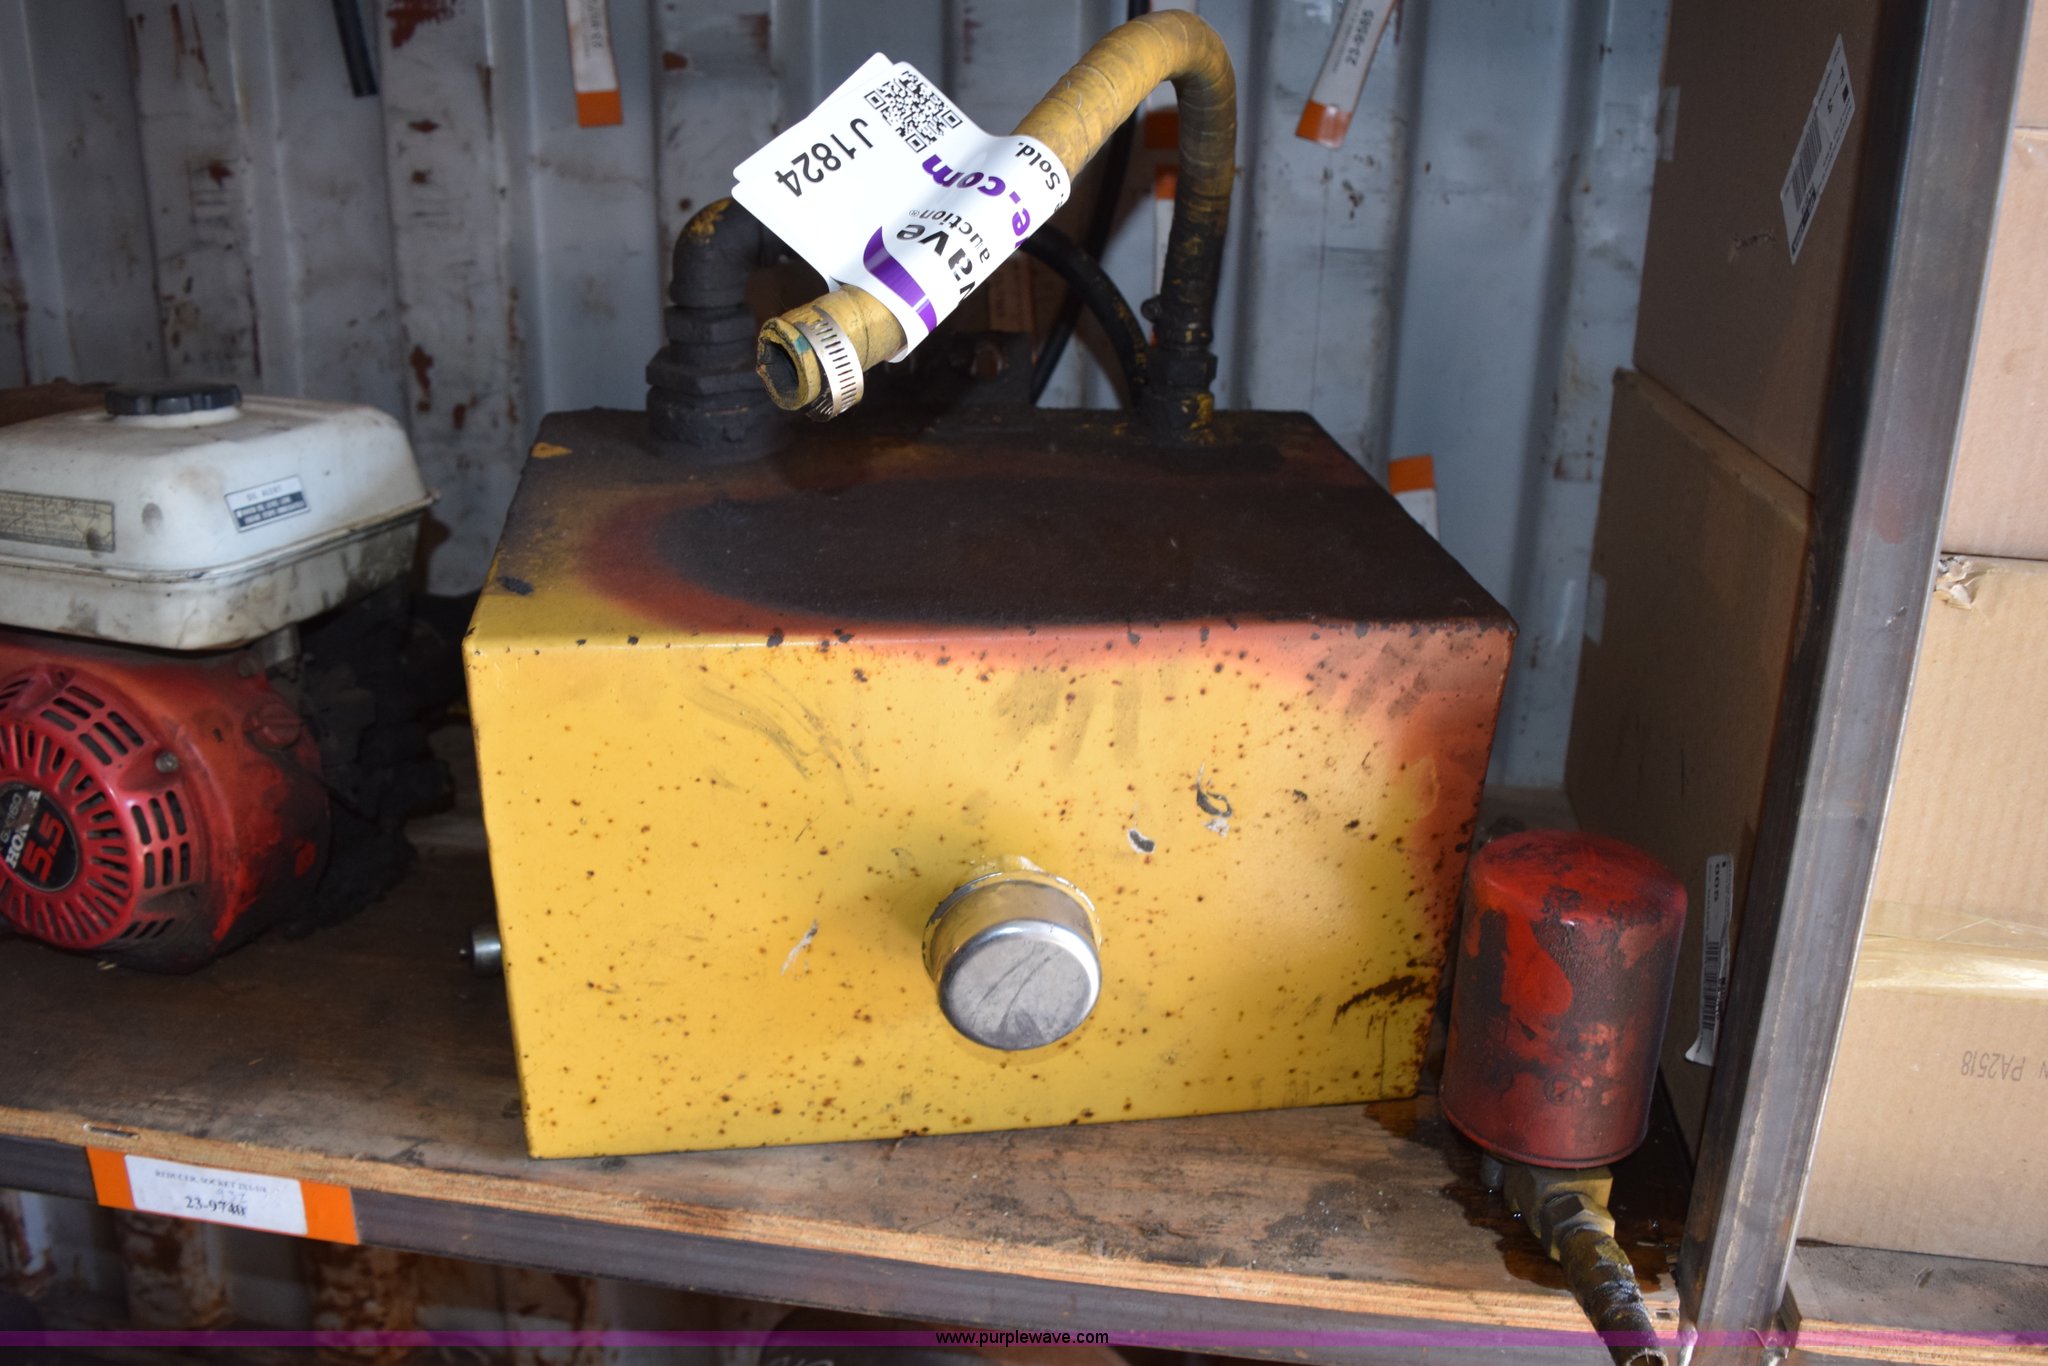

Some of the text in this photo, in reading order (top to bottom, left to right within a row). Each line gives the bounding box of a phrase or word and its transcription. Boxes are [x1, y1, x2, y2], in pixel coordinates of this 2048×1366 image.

[1015, 142, 1061, 190] Sold.
[921, 153, 1032, 249] e.com
[22, 812, 65, 882] 5.5
[1960, 1050, 2026, 1082] PA2518
